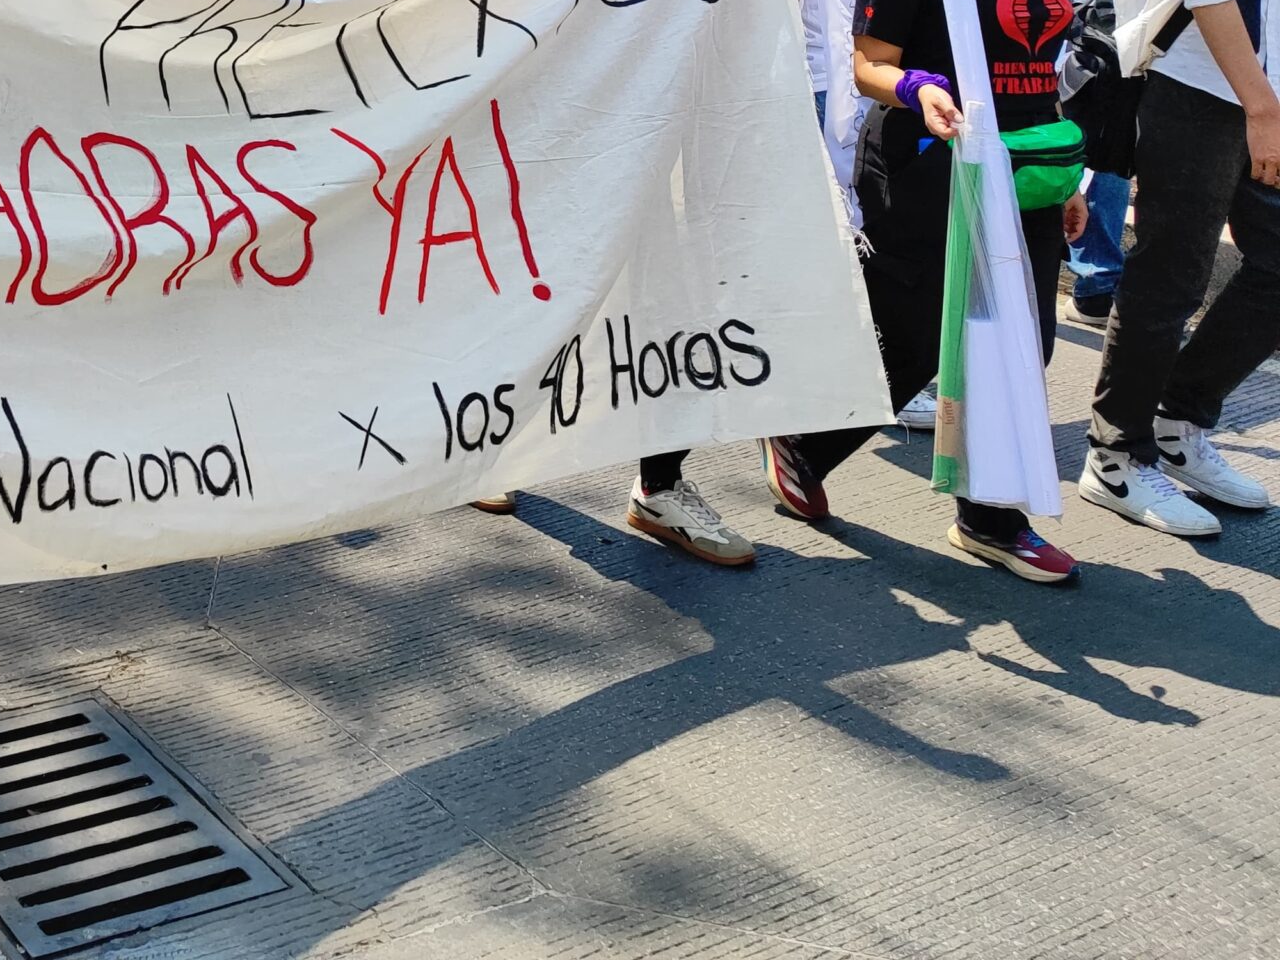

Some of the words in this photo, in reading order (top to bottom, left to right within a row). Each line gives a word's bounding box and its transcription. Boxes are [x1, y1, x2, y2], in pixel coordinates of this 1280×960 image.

[993, 61, 1026, 75] BIEN
[1029, 61, 1053, 74] POR
[330, 98, 553, 316] YA!
[432, 381, 516, 462] las
[538, 333, 586, 435] 40
[605, 312, 772, 410] Horas
